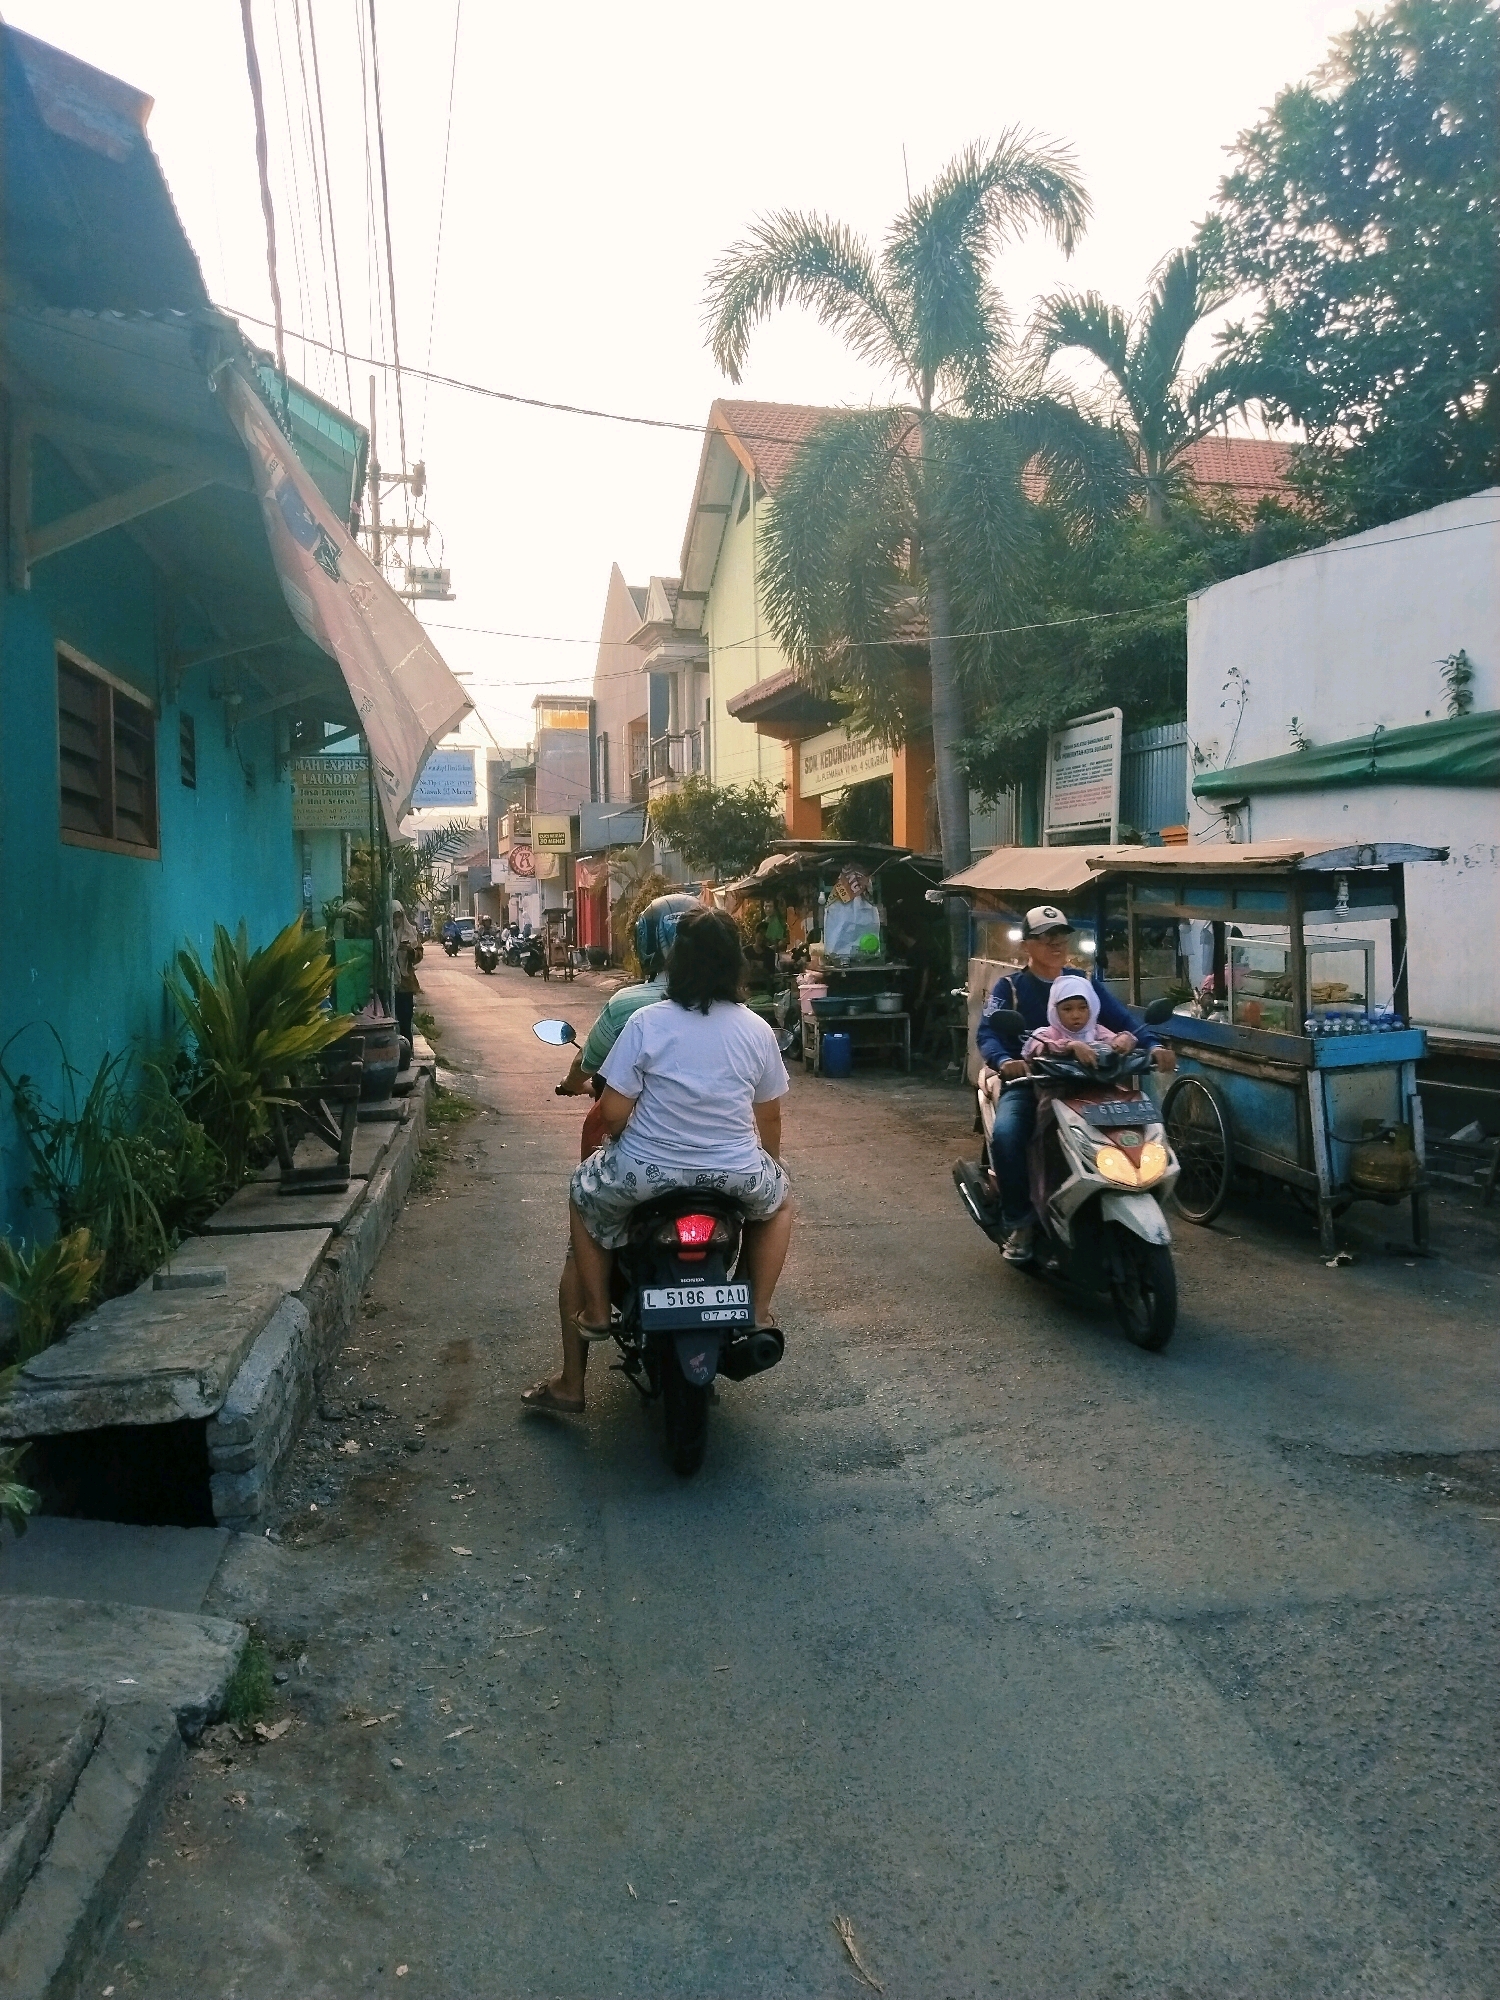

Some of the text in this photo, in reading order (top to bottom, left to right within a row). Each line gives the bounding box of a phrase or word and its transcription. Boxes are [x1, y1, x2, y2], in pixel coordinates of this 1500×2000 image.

[303, 774, 357, 785] LAUNDRY
[646, 1288, 746, 1308] L 5186 CAU
